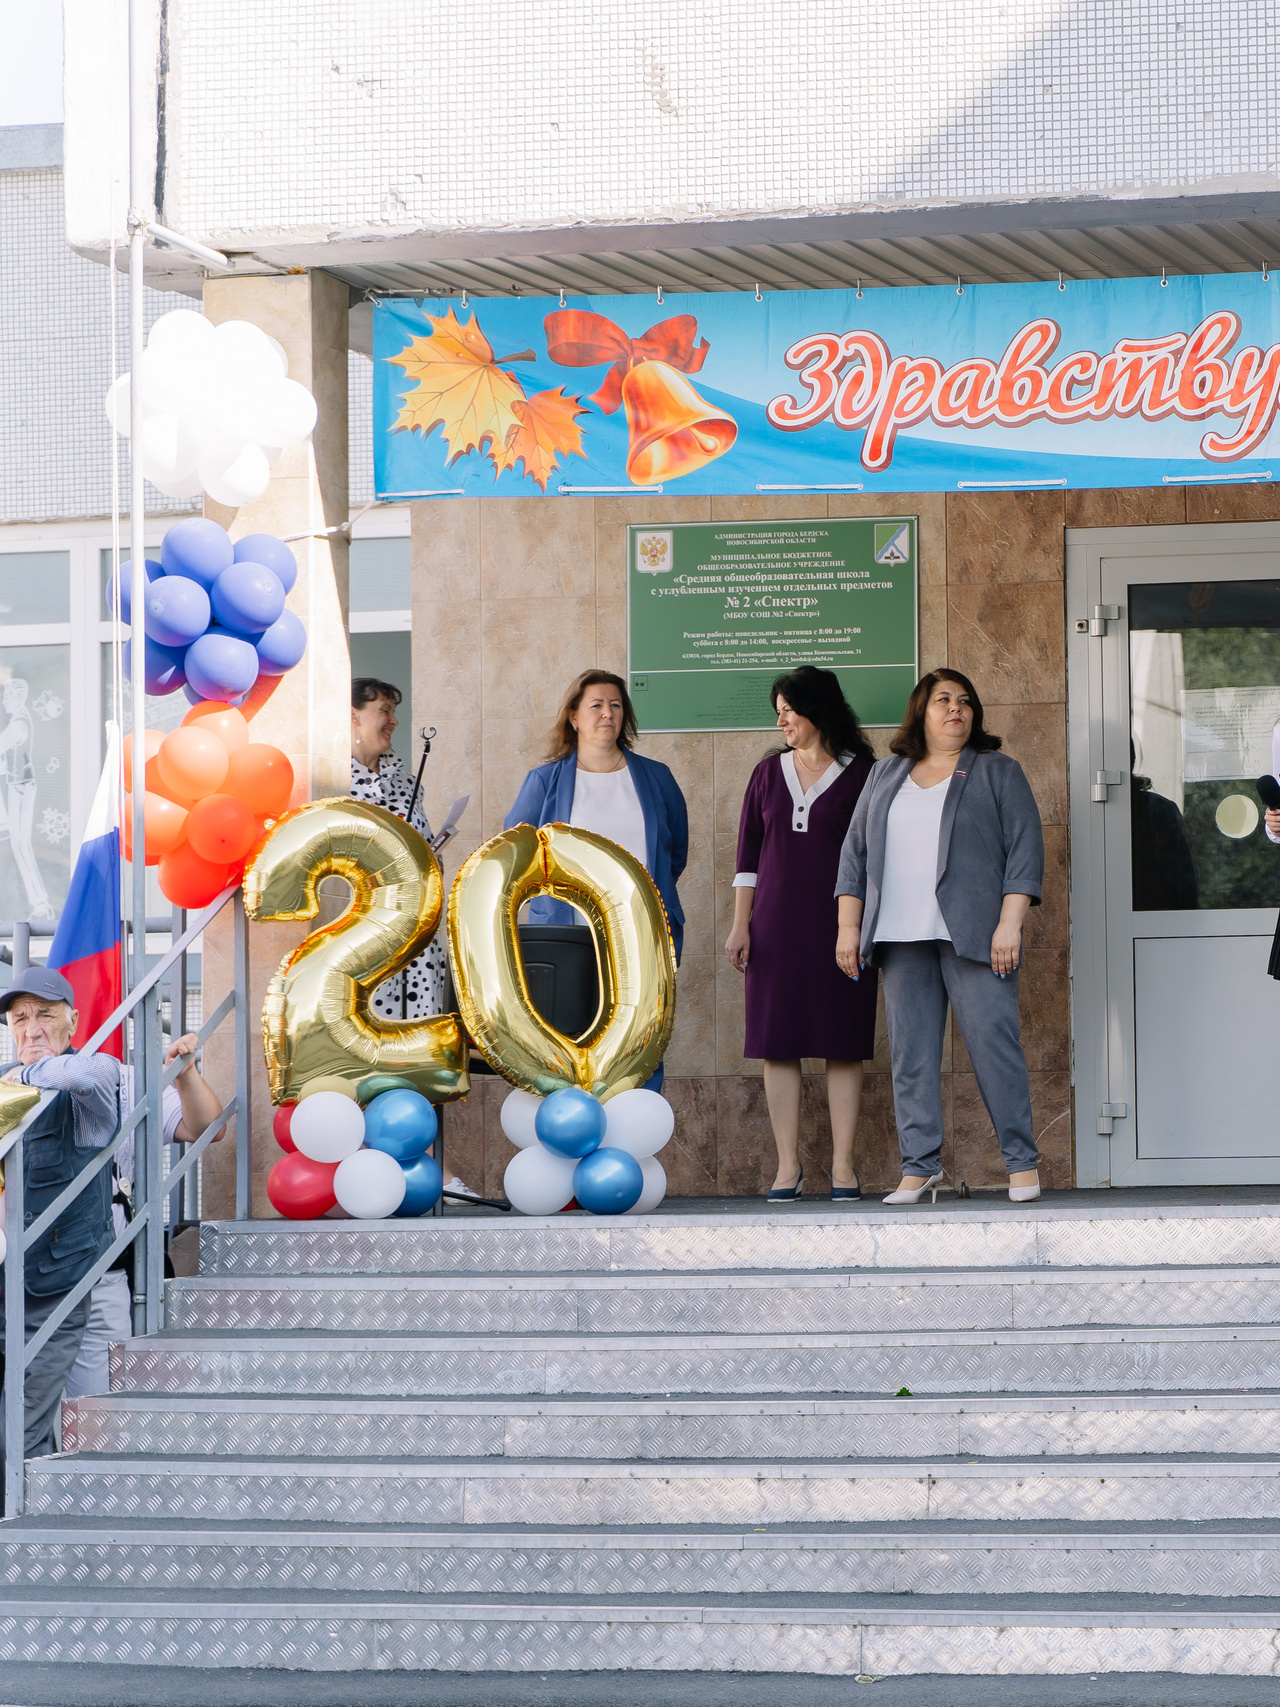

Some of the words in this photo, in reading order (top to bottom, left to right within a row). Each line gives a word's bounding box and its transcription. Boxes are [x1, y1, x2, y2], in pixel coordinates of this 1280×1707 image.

[713, 532, 773, 540] АДМИНИСТРАЦИЯ
[726, 538, 785, 546] НОВОСИБИРСКОЙ
[710, 553, 782, 561] МУНИЦИПАЛЬНОЕ
[782, 551, 833, 560] БЮДЖЕТНОЕ
[697, 562, 792, 571] ОБЩЕОБРАЗОВАТЕЛЬНОЕ
[792, 560, 846, 568] УЧРЕЖДЕНИЕ
[673, 574, 722, 585] «Средняя
[724, 572, 834, 583] общеобразовательная
[836, 570, 870, 579] школа
[650, 588, 657, 596] с
[658, 585, 726, 598] углубленным
[728, 584, 781, 595] изучением
[783, 583, 838, 592] отдельных
[840, 581, 893, 592] предметов
[724, 596, 740, 608] №
[743, 596, 751, 608] 2
[754, 595, 819, 609] «Спектр»
[723, 611, 750, 620] (МБОУ
[750, 611, 771, 619] СОШ
[771, 610, 784, 618] №2
[784, 609, 820, 618] «Спектр»)
[683, 631, 706, 639] Режим
[706, 631, 734, 640] работы:
[693, 640, 718, 648] суббота
[242, 796, 677, 1106] 20
